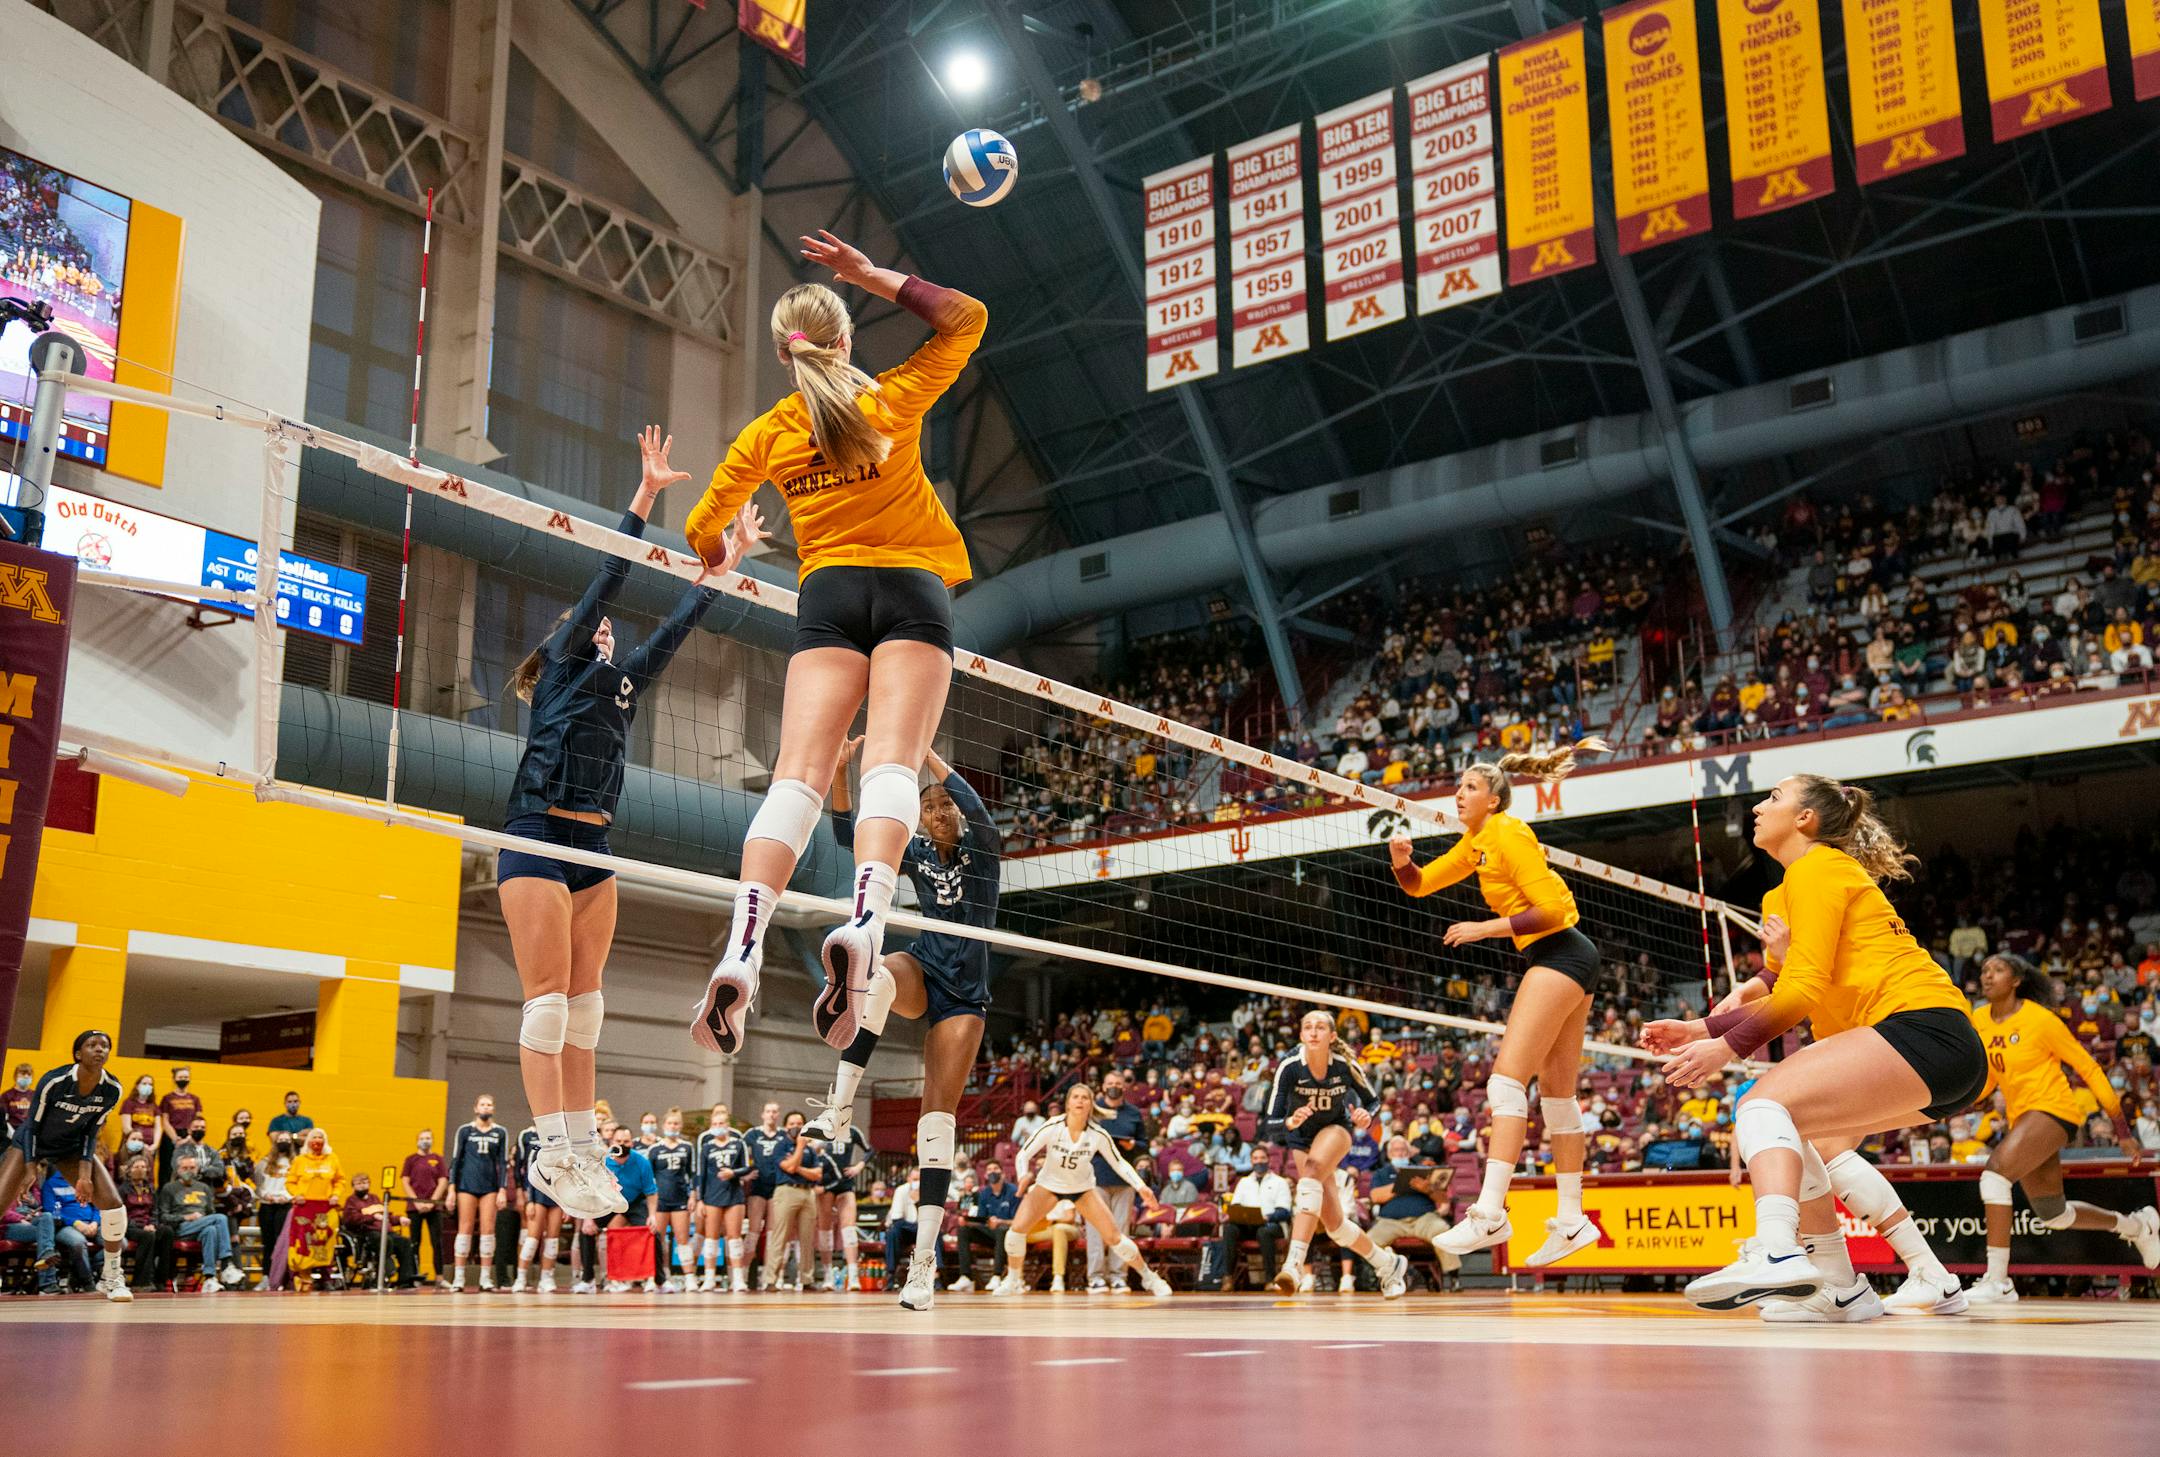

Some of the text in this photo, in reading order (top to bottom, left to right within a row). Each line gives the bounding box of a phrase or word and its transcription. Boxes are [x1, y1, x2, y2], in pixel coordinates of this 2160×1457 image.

[1746, 19, 1772, 35] TOP
[2005, 2, 2041, 24] 2002
[1740, 22, 1802, 53] FINISHES
[2007, 18, 2043, 39] 2003
[2009, 33, 2044, 54] 2004
[1512, 57, 1571, 87] NATIONAL
[2011, 48, 2045, 70] 2005
[2013, 58, 2081, 86] WRESTLING
[1522, 74, 1563, 97] DUALS
[1624, 62, 1685, 92] FINISHES
[1413, 74, 1485, 117] BIG TEN
[1507, 81, 1581, 116] CHAMPIONS
[2021, 81, 2085, 126] M
[1413, 96, 1487, 132] CHAMPIONS
[1322, 109, 1389, 150] BIG TEN
[1424, 124, 1478, 160] 2003
[1232, 142, 1297, 181] BIG TEN
[1322, 130, 1390, 164] CHAMPIONS
[1882, 130, 1938, 171] M
[1232, 162, 1298, 195] CHAMPIONS
[1333, 157, 1384, 190] 1999
[1426, 166, 1481, 202] 2006
[1758, 166, 1812, 206] M
[1149, 174, 1209, 208] BIG TEN
[1243, 190, 1289, 221] 1941
[1149, 192, 1211, 223] CHAMPIONS
[1334, 198, 1384, 232] 2001
[1641, 204, 1689, 241] M
[1157, 219, 1203, 249] 1910
[1428, 208, 1483, 244] 2007
[1244, 229, 1291, 260] 1957
[1337, 239, 1388, 272] 2002
[1433, 243, 1481, 265] WRESTLING
[1530, 239, 1575, 274] M
[1158, 257, 1204, 288] 1912
[1245, 269, 1294, 299] 1959
[1341, 271, 1387, 293] WRESTLING
[1438, 267, 1479, 300] M
[1159, 296, 1205, 326] 1913
[1247, 301, 1292, 321] WRESTLING
[1346, 294, 1385, 328] M
[1161, 328, 1203, 346] WRESTLING
[1251, 324, 1289, 355] M
[1165, 350, 1200, 379] M
[57, 501, 138, 537] Old Dutch
[547, 510, 576, 536] M
[646, 545, 672, 567] M
[206, 562, 231, 578] AST
[302, 588, 332, 606] BLKS
[332, 596, 363, 614] KILLS
[736, 576, 761, 598] M
[970, 655, 988, 674] M
[1036, 677, 1053, 695] M
[1098, 698, 1114, 716] M
[1156, 718, 1172, 735] M
[1701, 752, 1753, 798] M
[1534, 783, 1563, 814] M
[1988, 1035, 2007, 1049] M
[1294, 1085, 1347, 1097] PENN STATE
[1308, 1095, 1332, 1112] 10
[667, 1156, 681, 1170] 12
[1060, 1155, 1079, 1170] 15
[1625, 1205, 1738, 1230] HEALTH
[1626, 1235, 1705, 1250] FAIRVIEW
